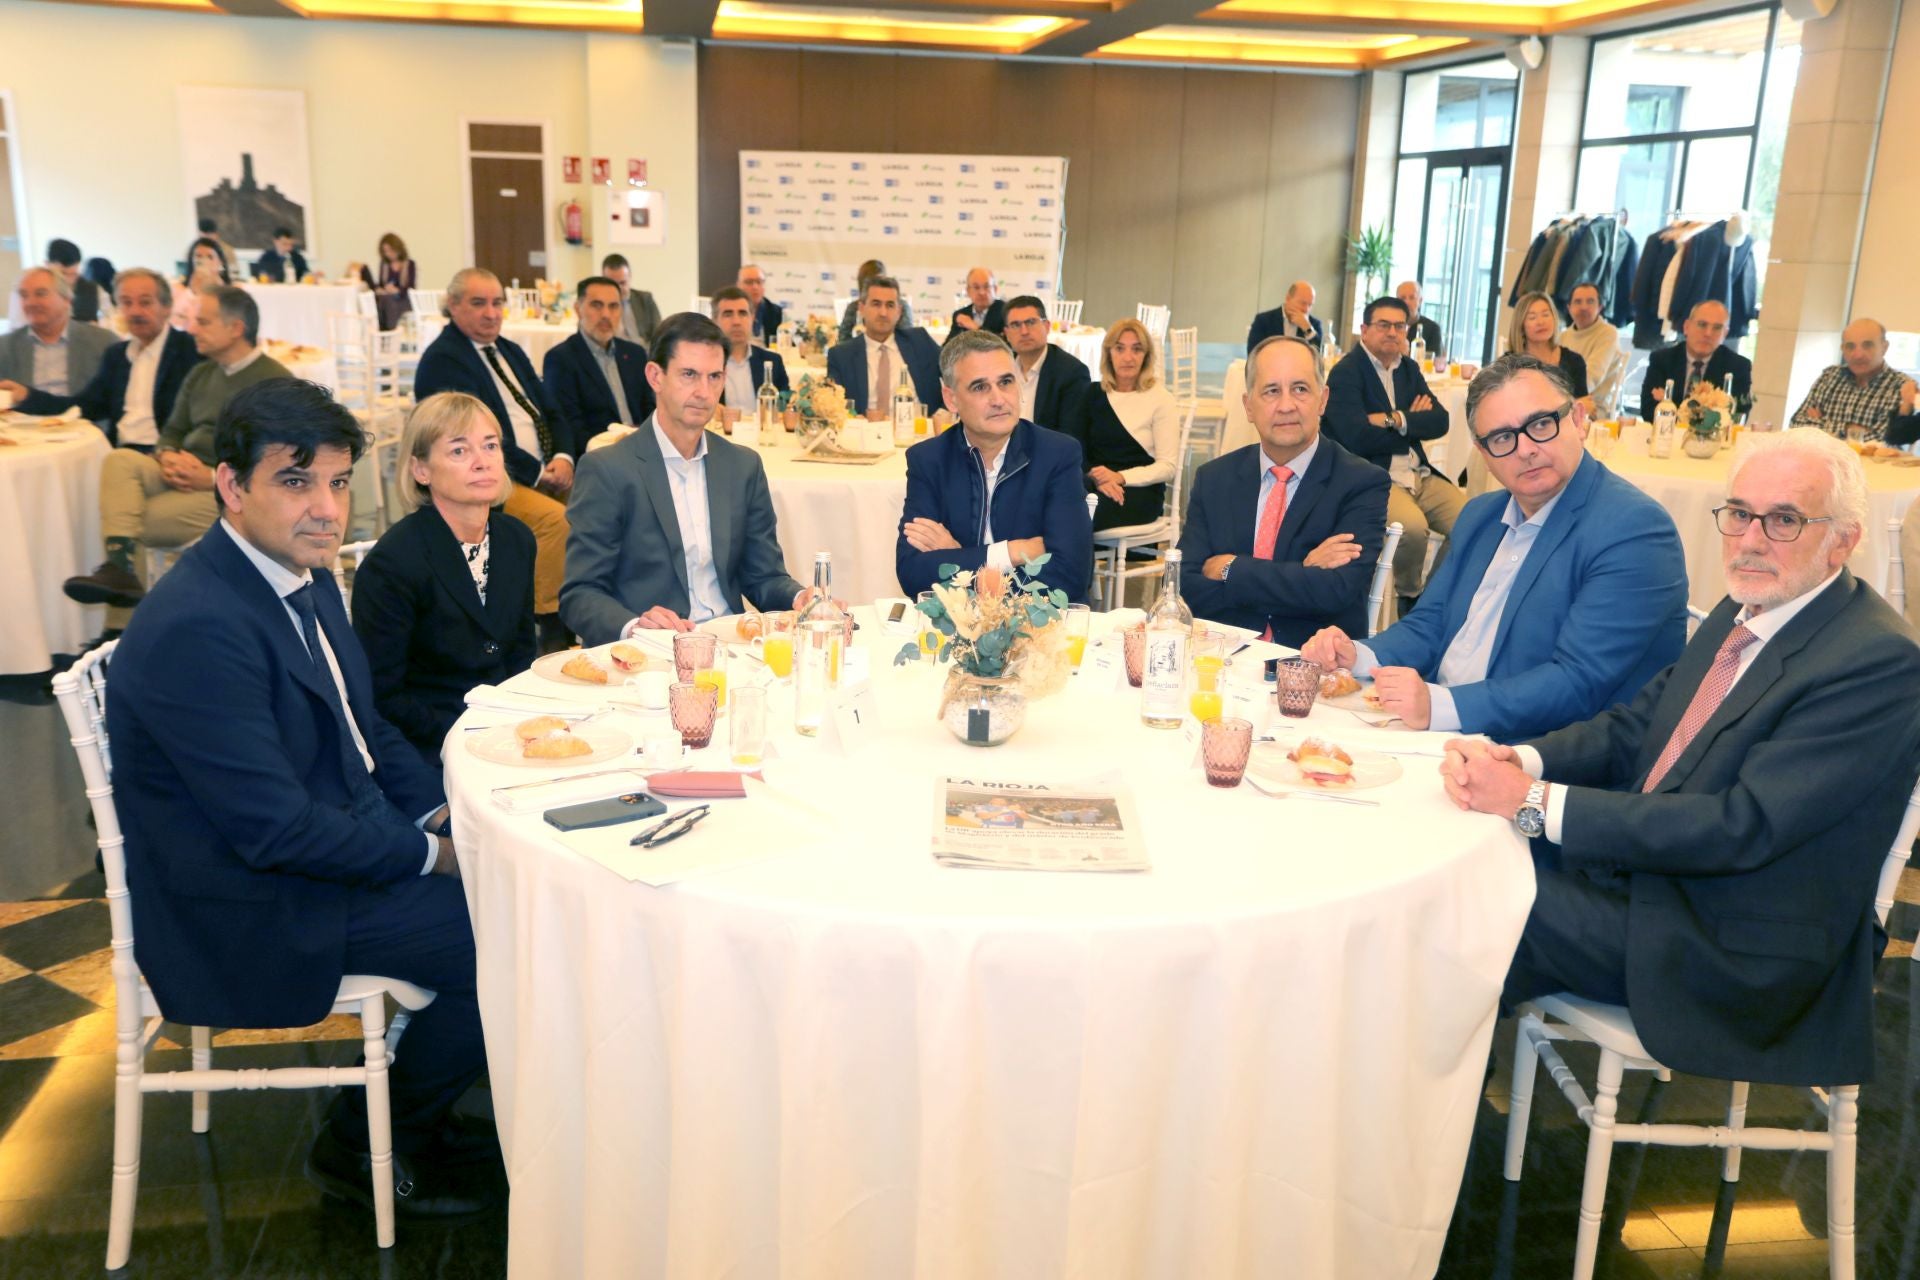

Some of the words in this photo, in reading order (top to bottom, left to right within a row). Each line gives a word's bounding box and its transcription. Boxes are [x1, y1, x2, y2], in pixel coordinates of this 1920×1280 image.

[853, 708, 860, 724] 1
[946, 778, 975, 786] LA
[982, 782, 1050, 790] RIOJA
